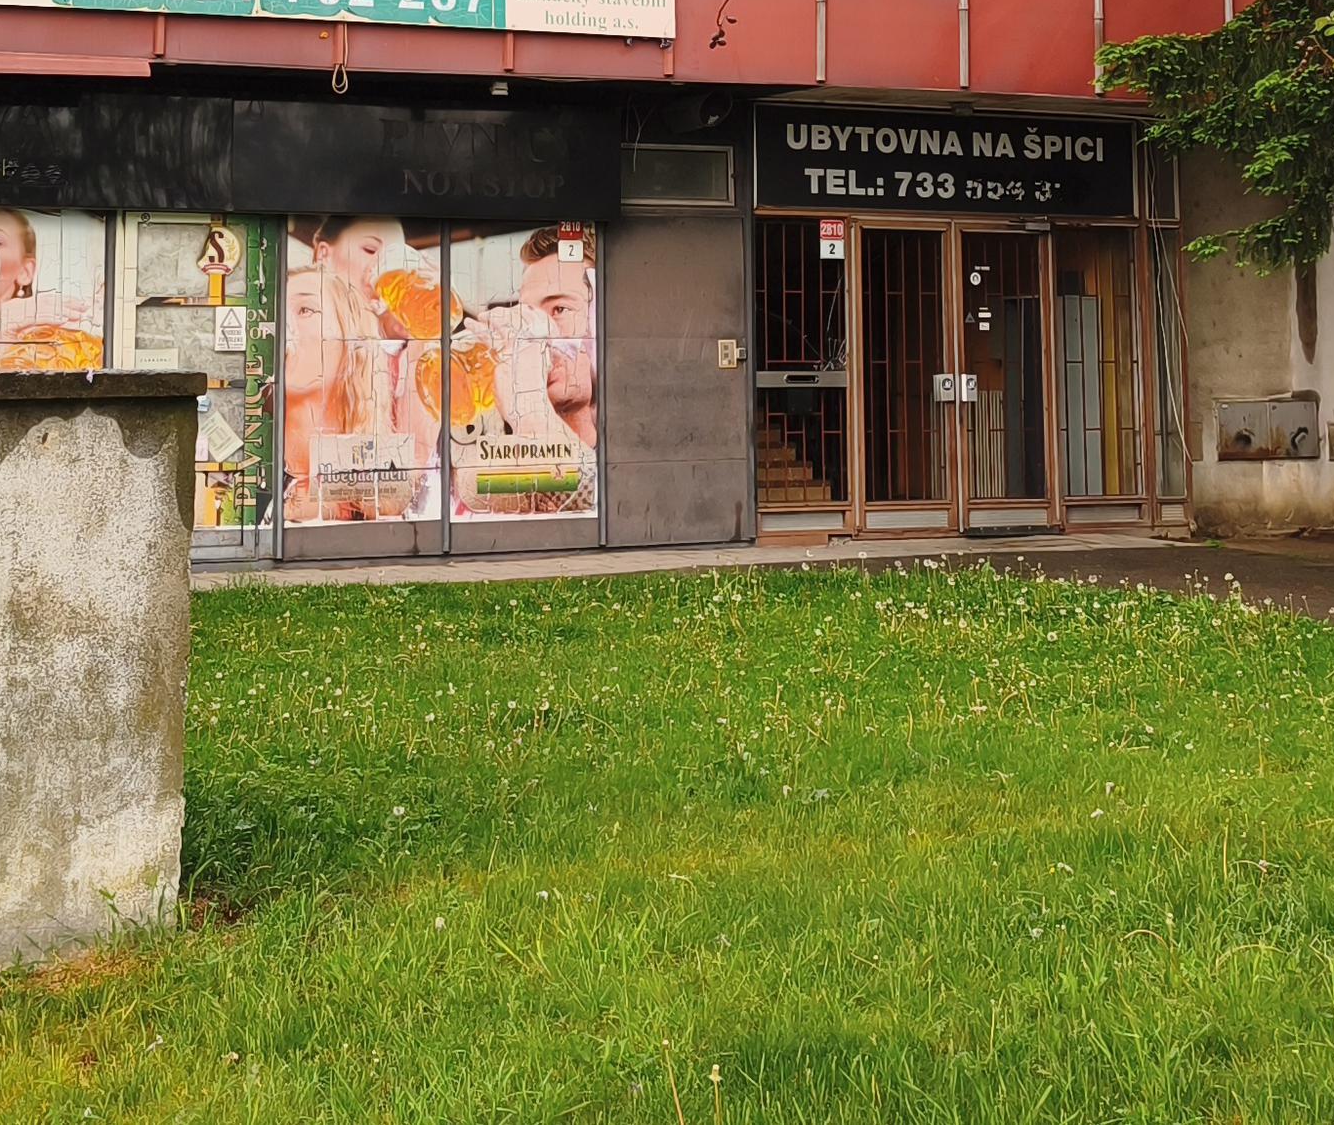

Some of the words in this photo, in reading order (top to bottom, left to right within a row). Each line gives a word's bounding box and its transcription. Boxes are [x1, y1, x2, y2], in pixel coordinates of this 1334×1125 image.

[545, 10, 608, 32] holding
[613, 17, 639, 30] a.s.
[786, 123, 964, 156] UBYTOVNA
[972, 132, 1015, 158] NA
[1023, 127, 1104, 162] ŠPICI
[804, 168, 885, 196] TEL.:
[894, 171, 956, 199] 733
[560, 221, 581, 232] 2810
[821, 223, 844, 236] 2810
[569, 244, 575, 257] 2
[829, 243, 836, 255] 2
[246, 309, 268, 322] ON
[318, 463, 408, 486] Hoegaaden
